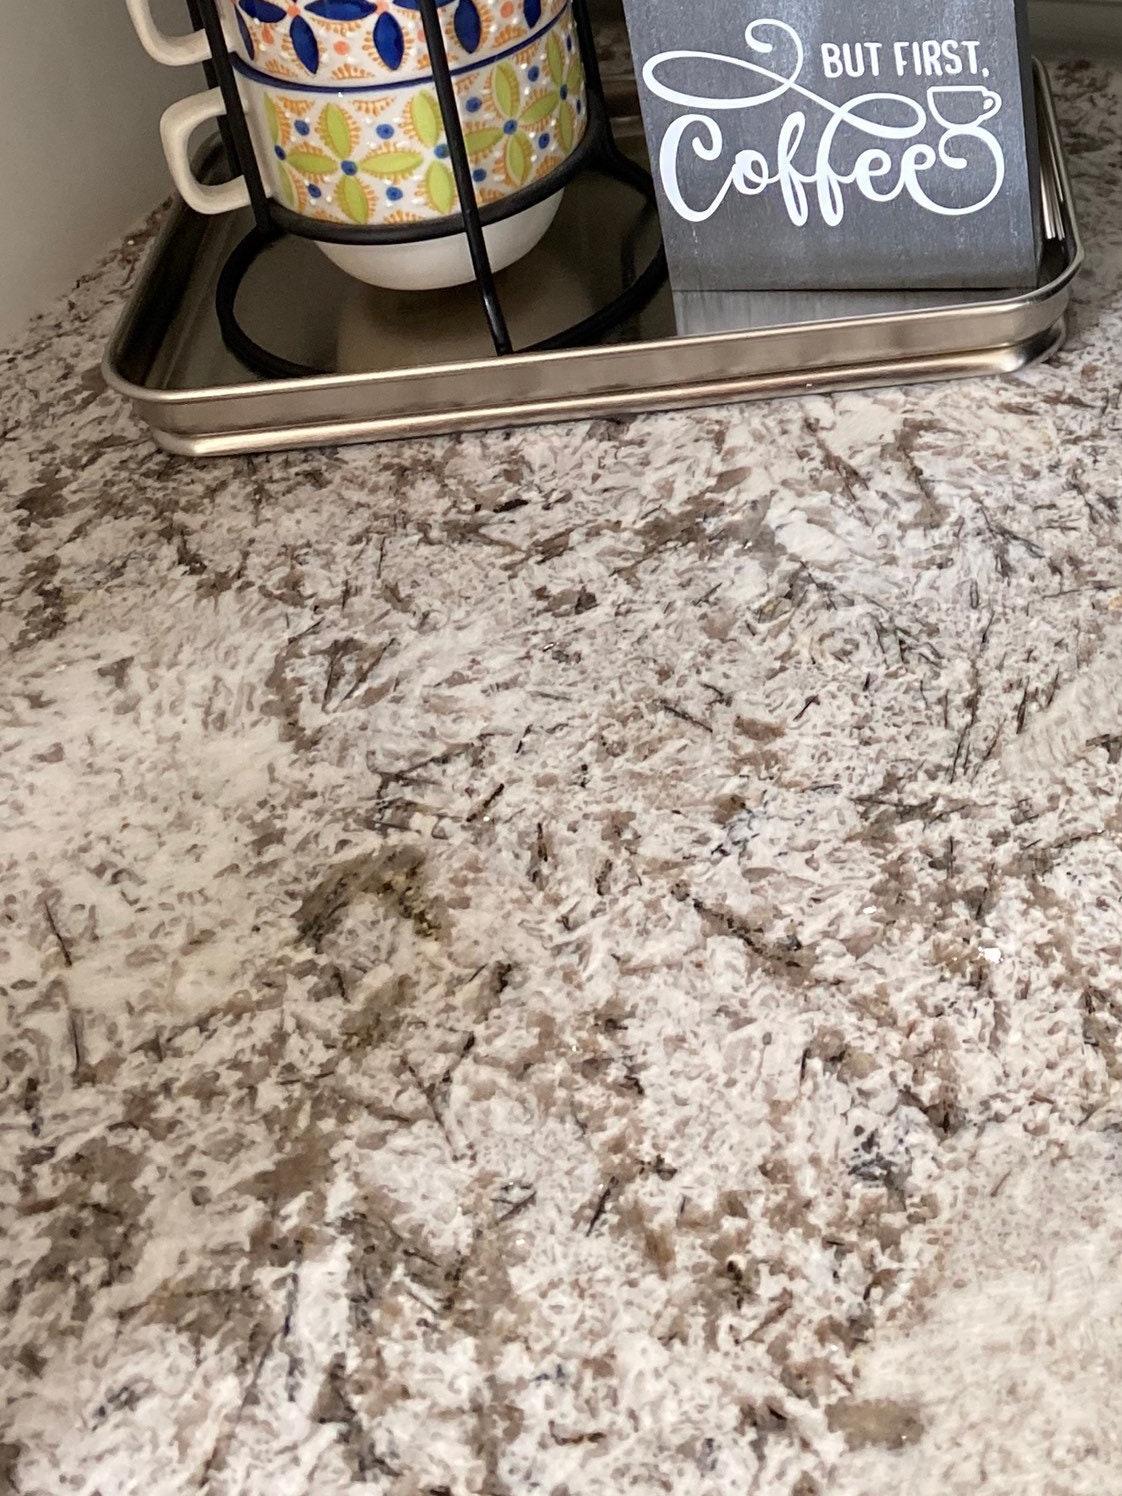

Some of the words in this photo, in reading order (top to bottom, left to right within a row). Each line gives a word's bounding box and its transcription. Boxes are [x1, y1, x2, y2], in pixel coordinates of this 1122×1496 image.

[821, 41, 882, 78] BUT
[894, 39, 990, 78] FIRST,
[642, 18, 1005, 227] Coffee
